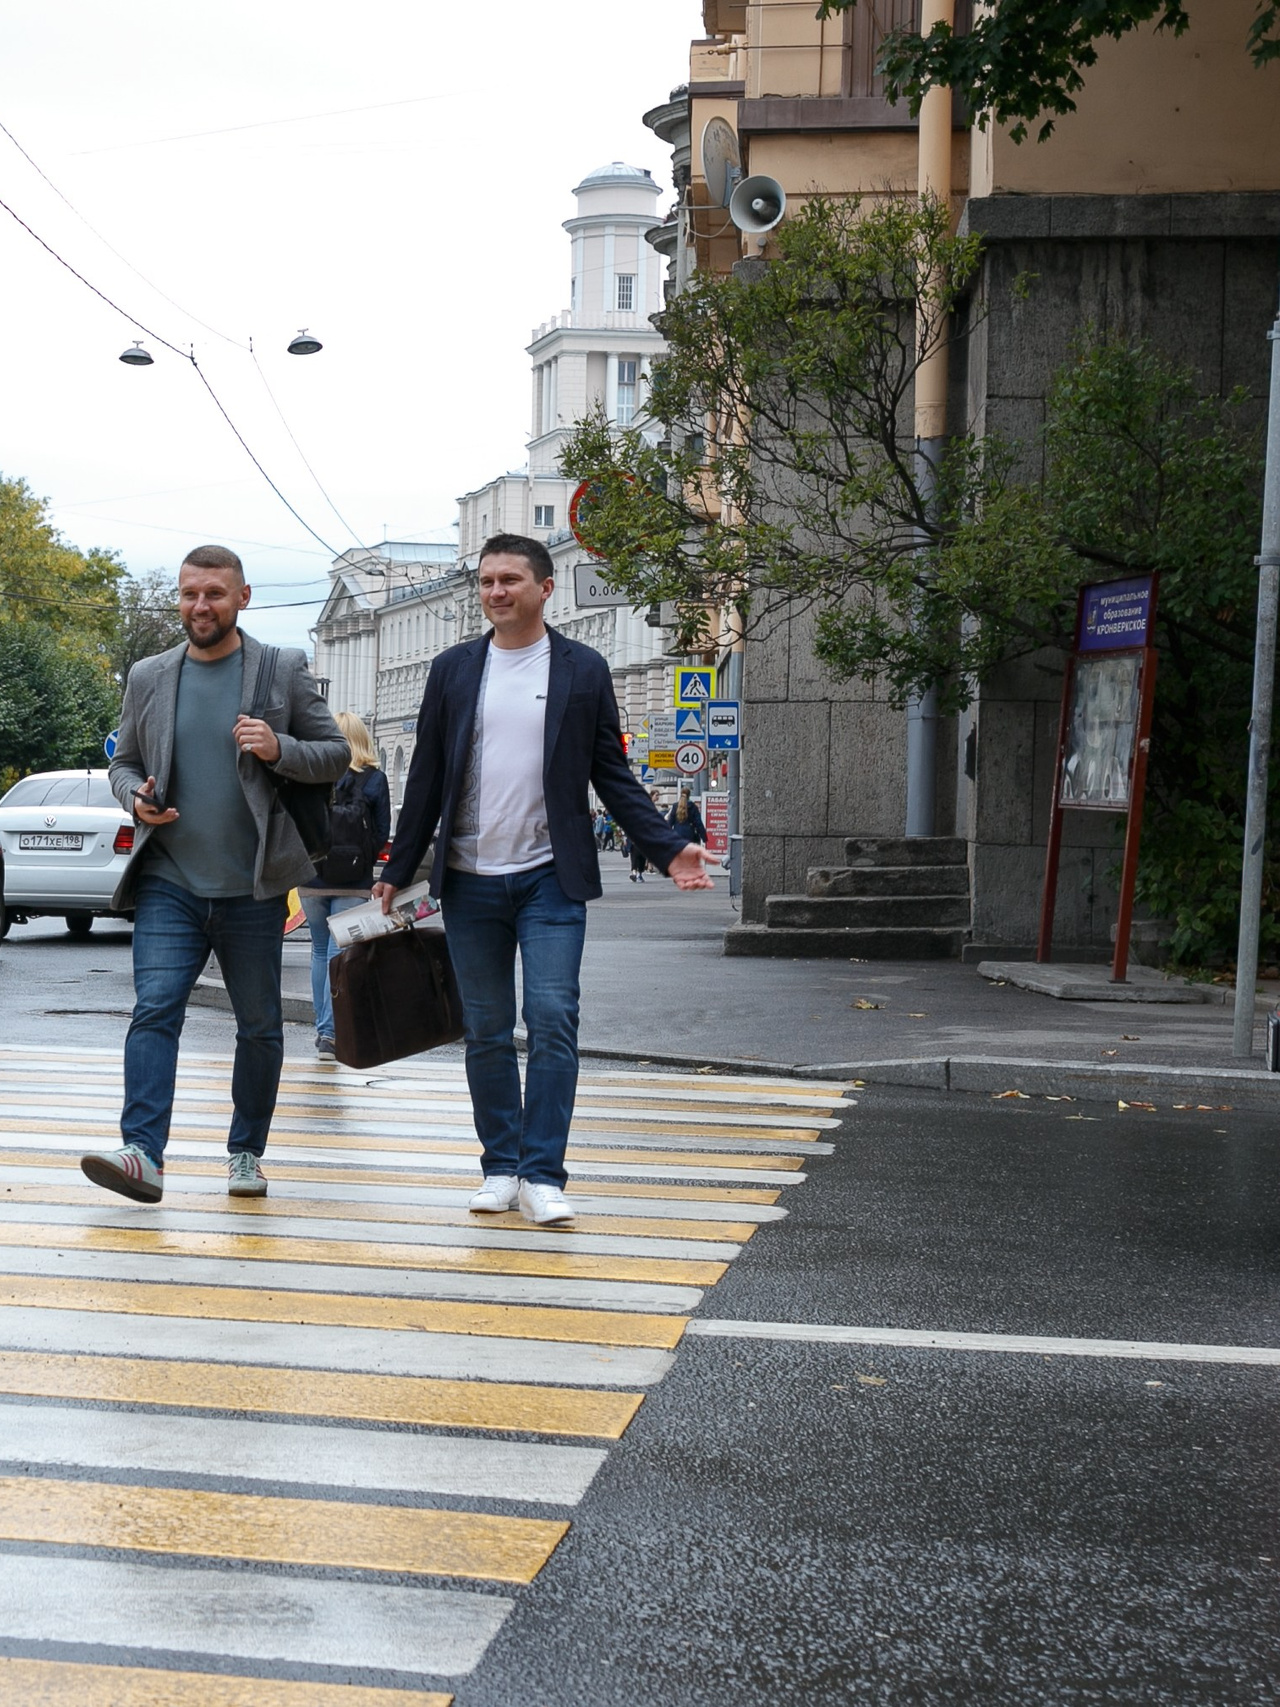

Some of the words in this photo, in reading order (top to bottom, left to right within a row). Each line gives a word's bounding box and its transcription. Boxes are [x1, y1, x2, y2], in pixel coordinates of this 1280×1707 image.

[1100, 590, 1149, 607] муниципальное
[1103, 606, 1142, 621] образование
[1096, 618, 1147, 635] КРОНВЕРКСКОЕ
[681, 752, 699, 765] 40
[64, 835, 80, 844] 198
